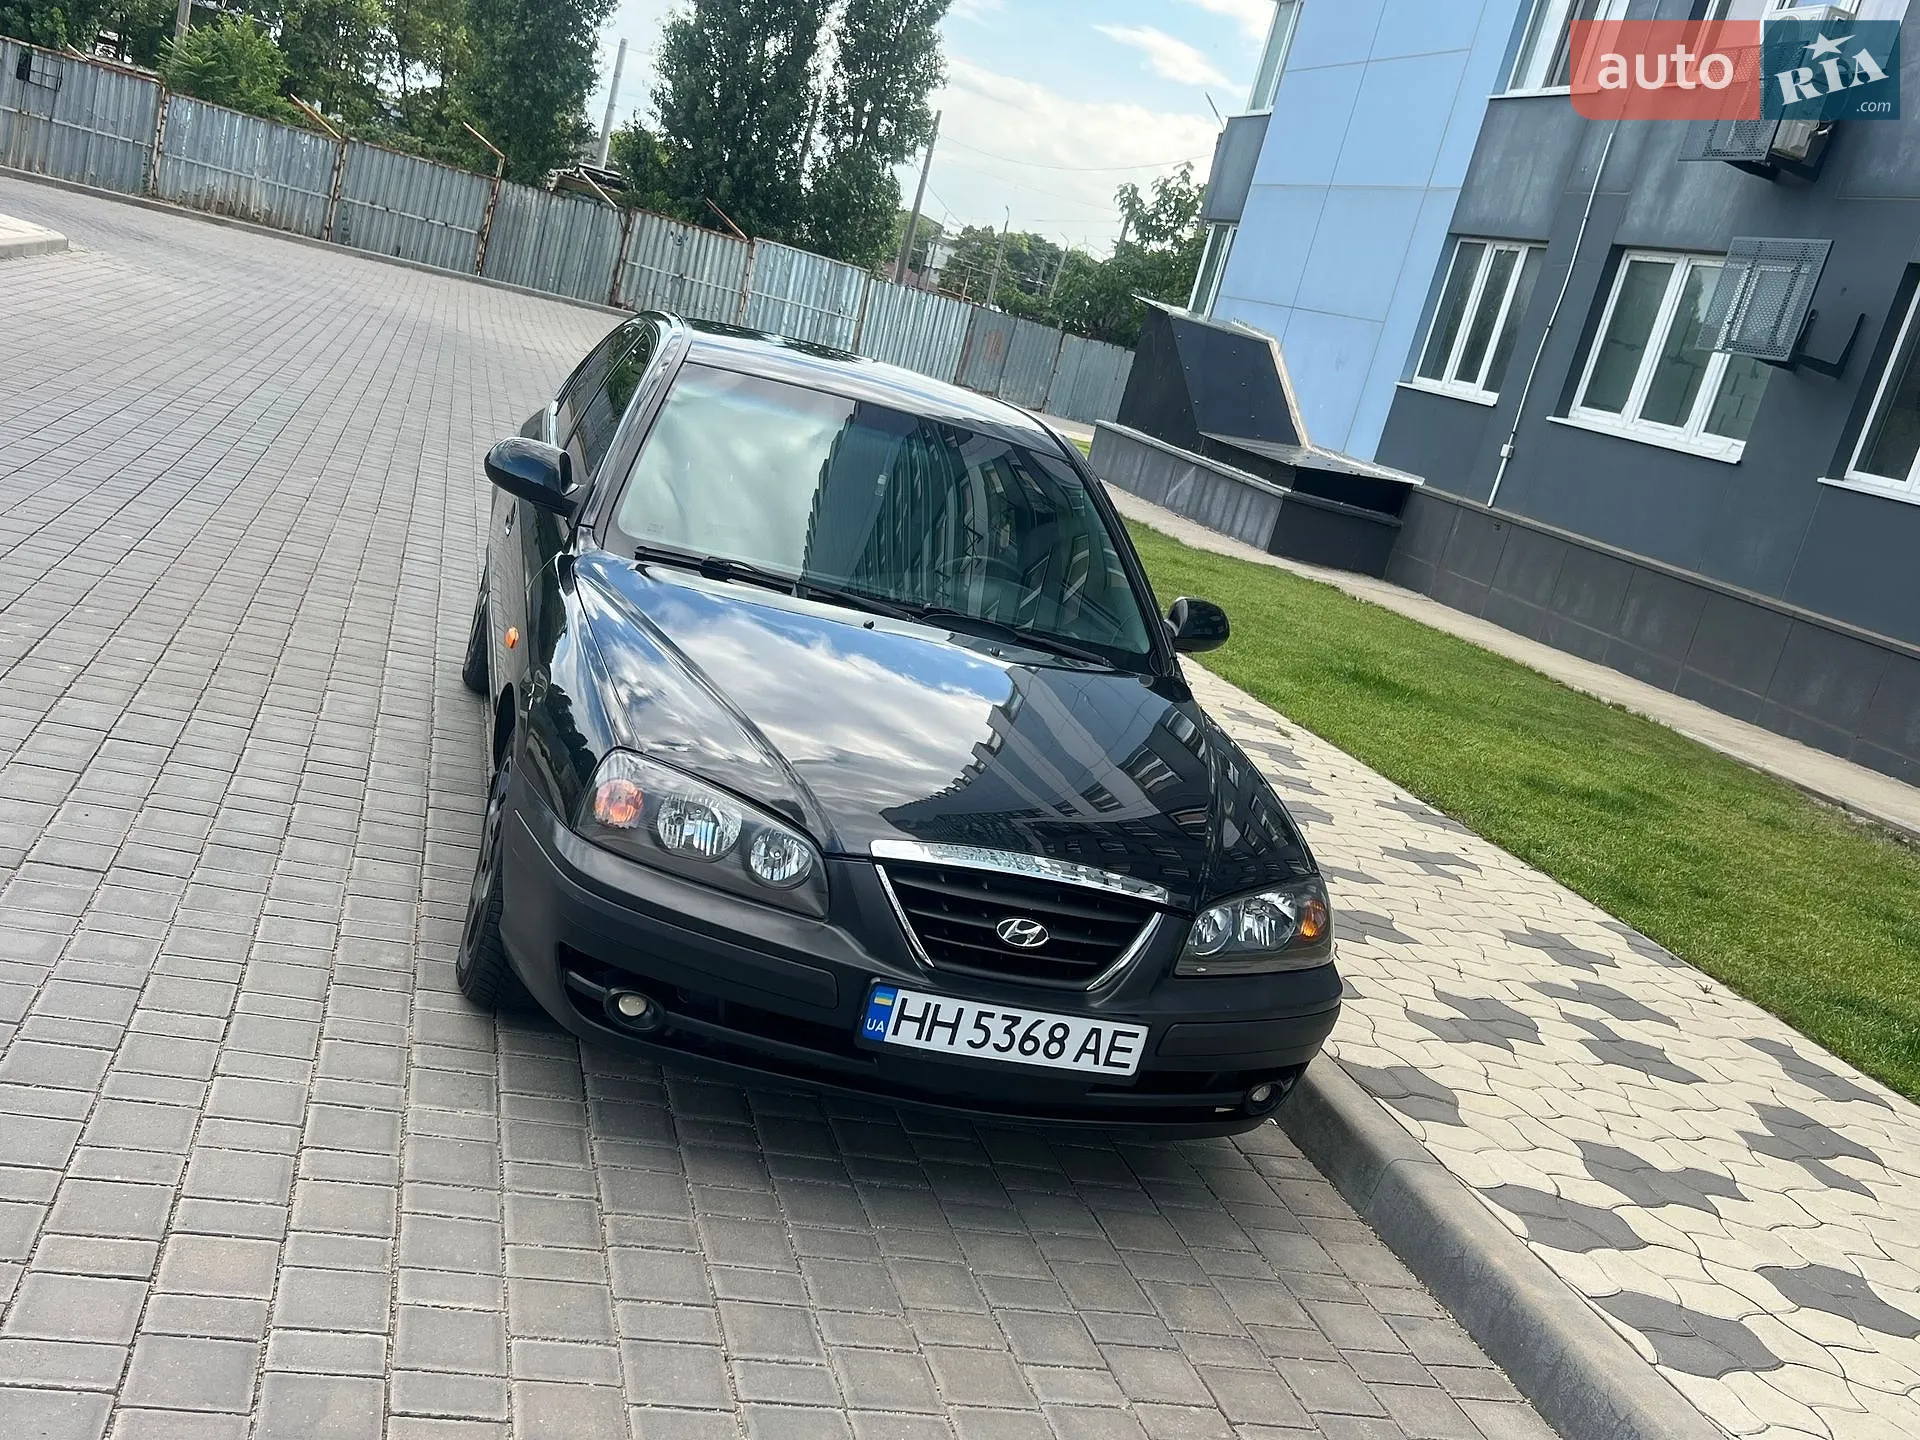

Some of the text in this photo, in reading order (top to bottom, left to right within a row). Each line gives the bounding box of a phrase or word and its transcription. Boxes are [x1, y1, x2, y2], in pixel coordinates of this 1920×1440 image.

[867, 1018, 885, 1033] UA
[891, 998, 1140, 1069] HH 5368 AE
